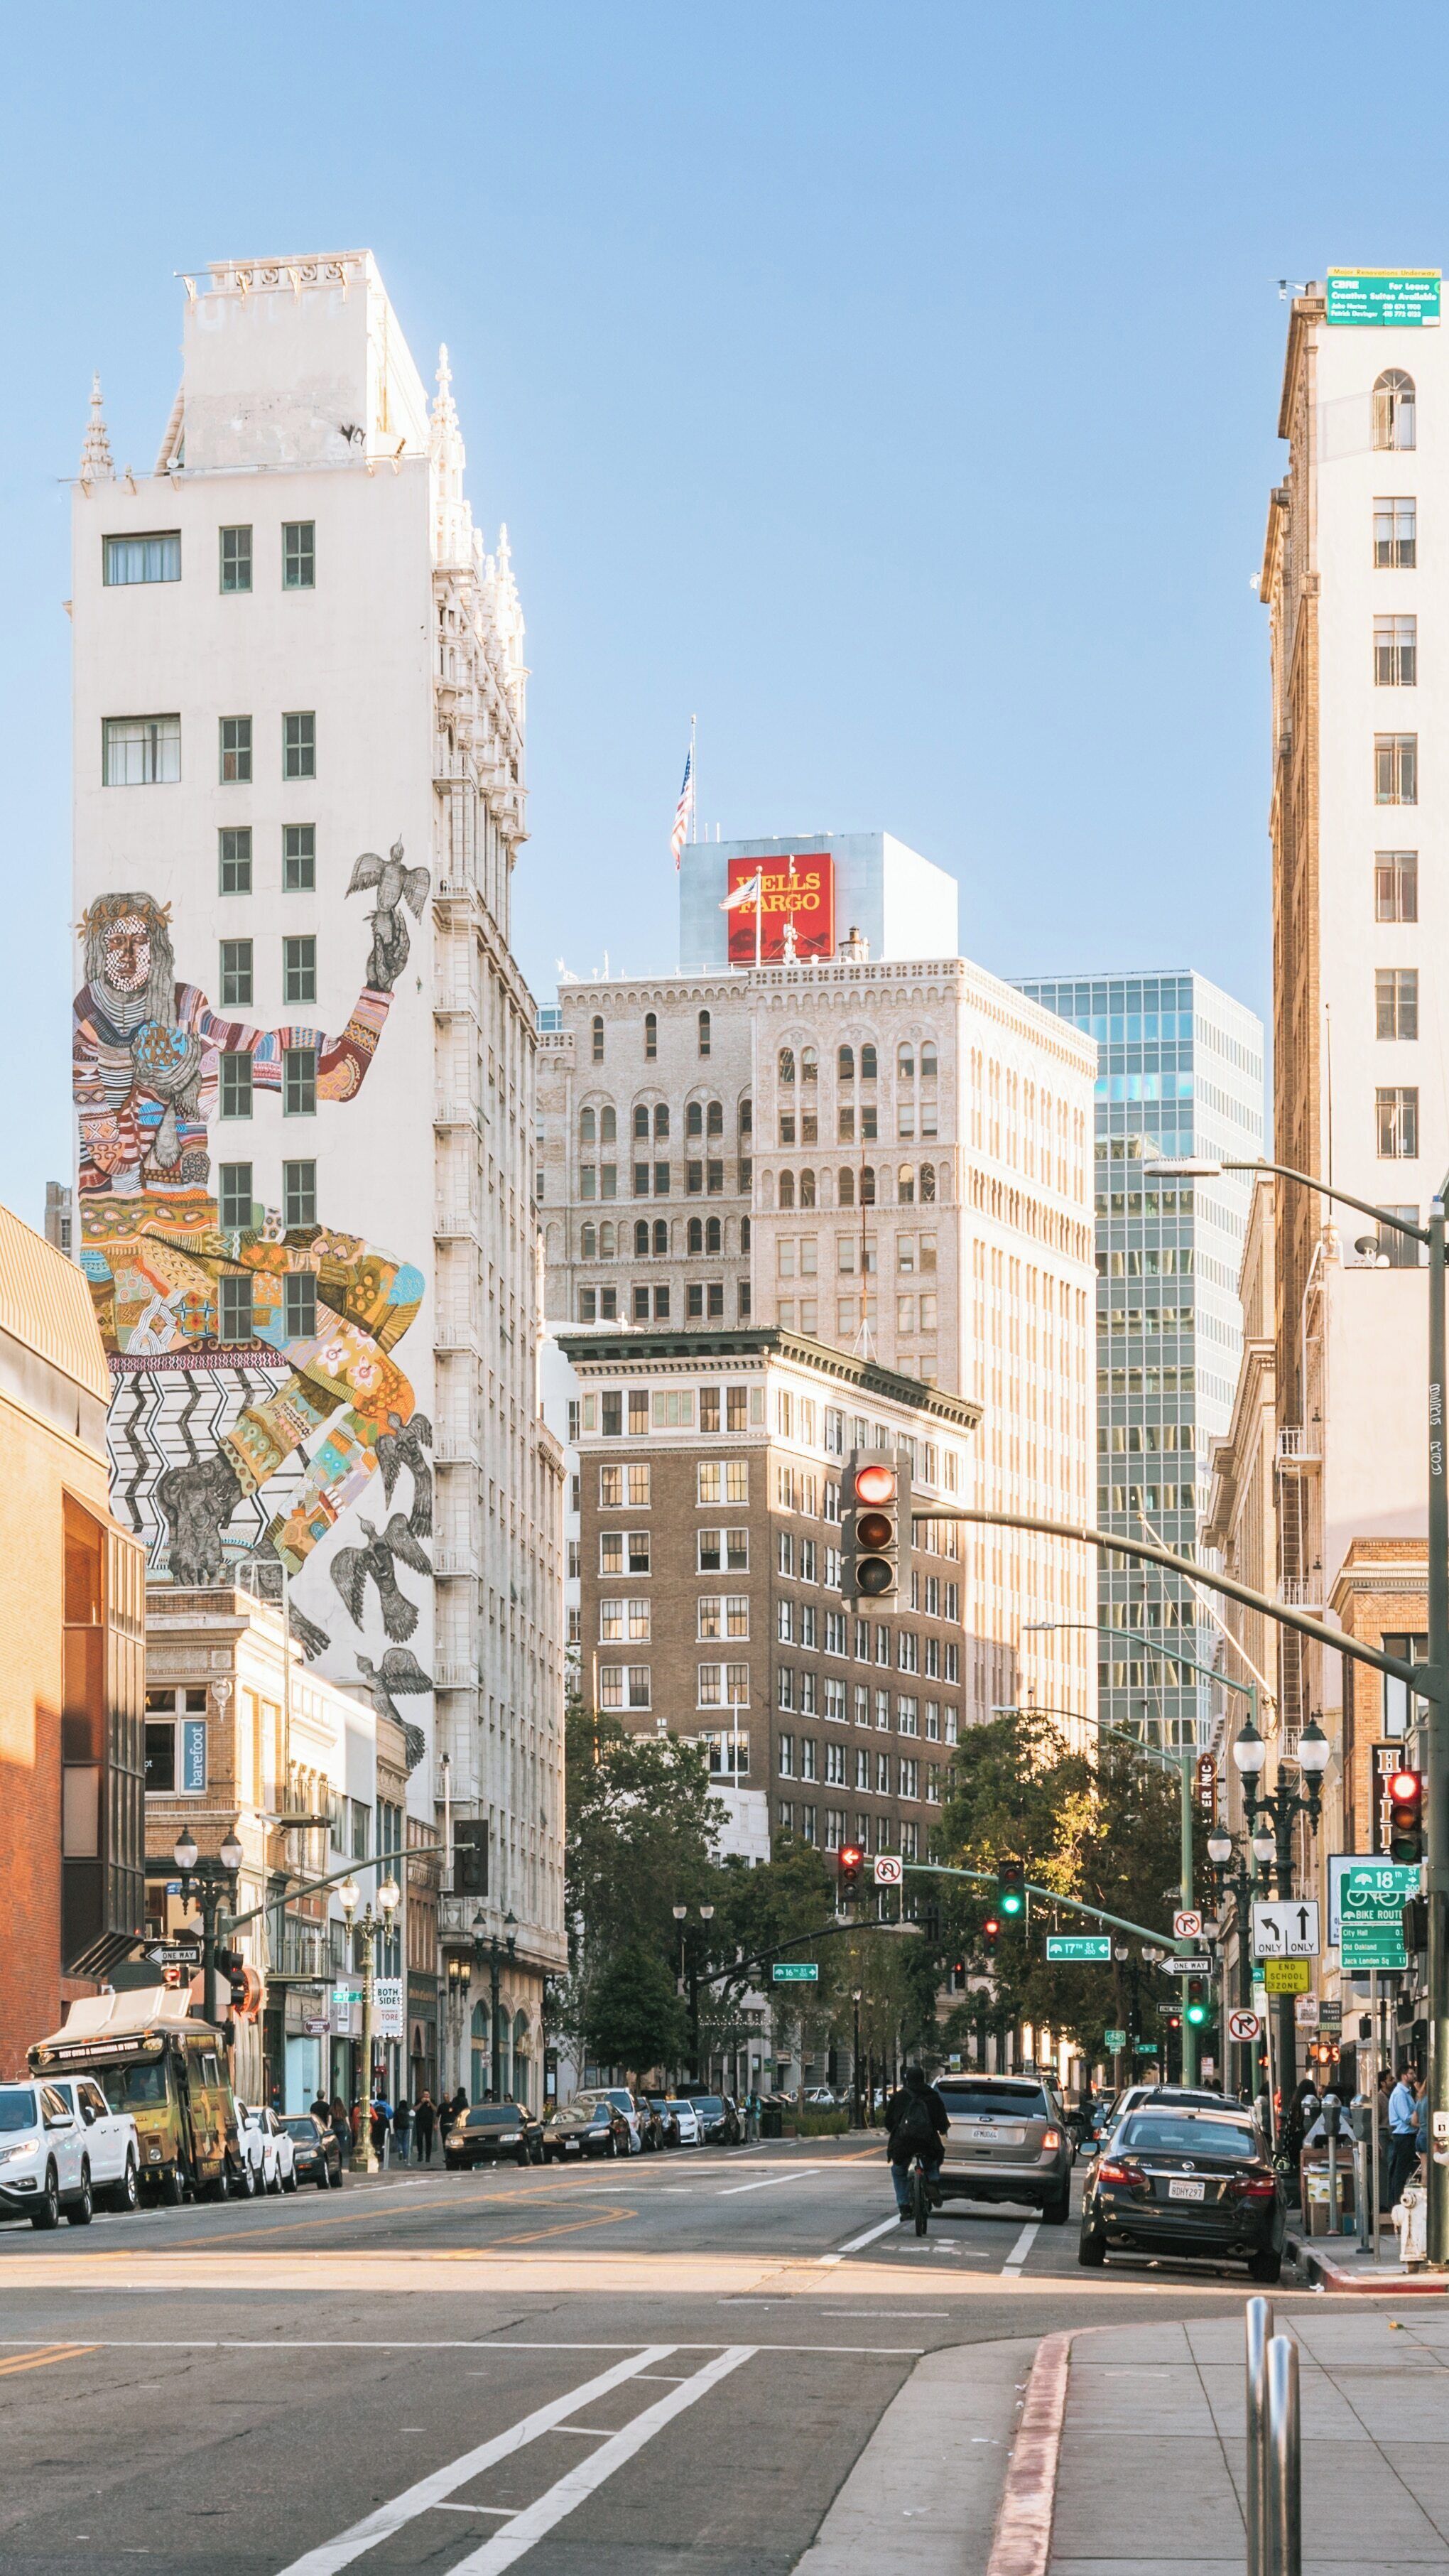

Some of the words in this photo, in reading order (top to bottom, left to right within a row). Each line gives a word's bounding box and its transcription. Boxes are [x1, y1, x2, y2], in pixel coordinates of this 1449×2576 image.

[1369, 292, 1396, 301] Suites
[1398, 292, 1437, 301] Available
[190, 1726, 203, 1787] barefoot
[1356, 1910, 1374, 1919] BIKE
[1377, 1910, 1402, 1919] ROUTE
[1342, 1929, 1355, 1937] City
[1259, 1944, 1282, 1952] ONLY
[1291, 1943, 1314, 1952] ONLY
[1382, 1957, 1389, 1966] Sq
[59, 2050, 71, 2059] BEST
[1172, 2187, 1202, 2197] 8DHY297
